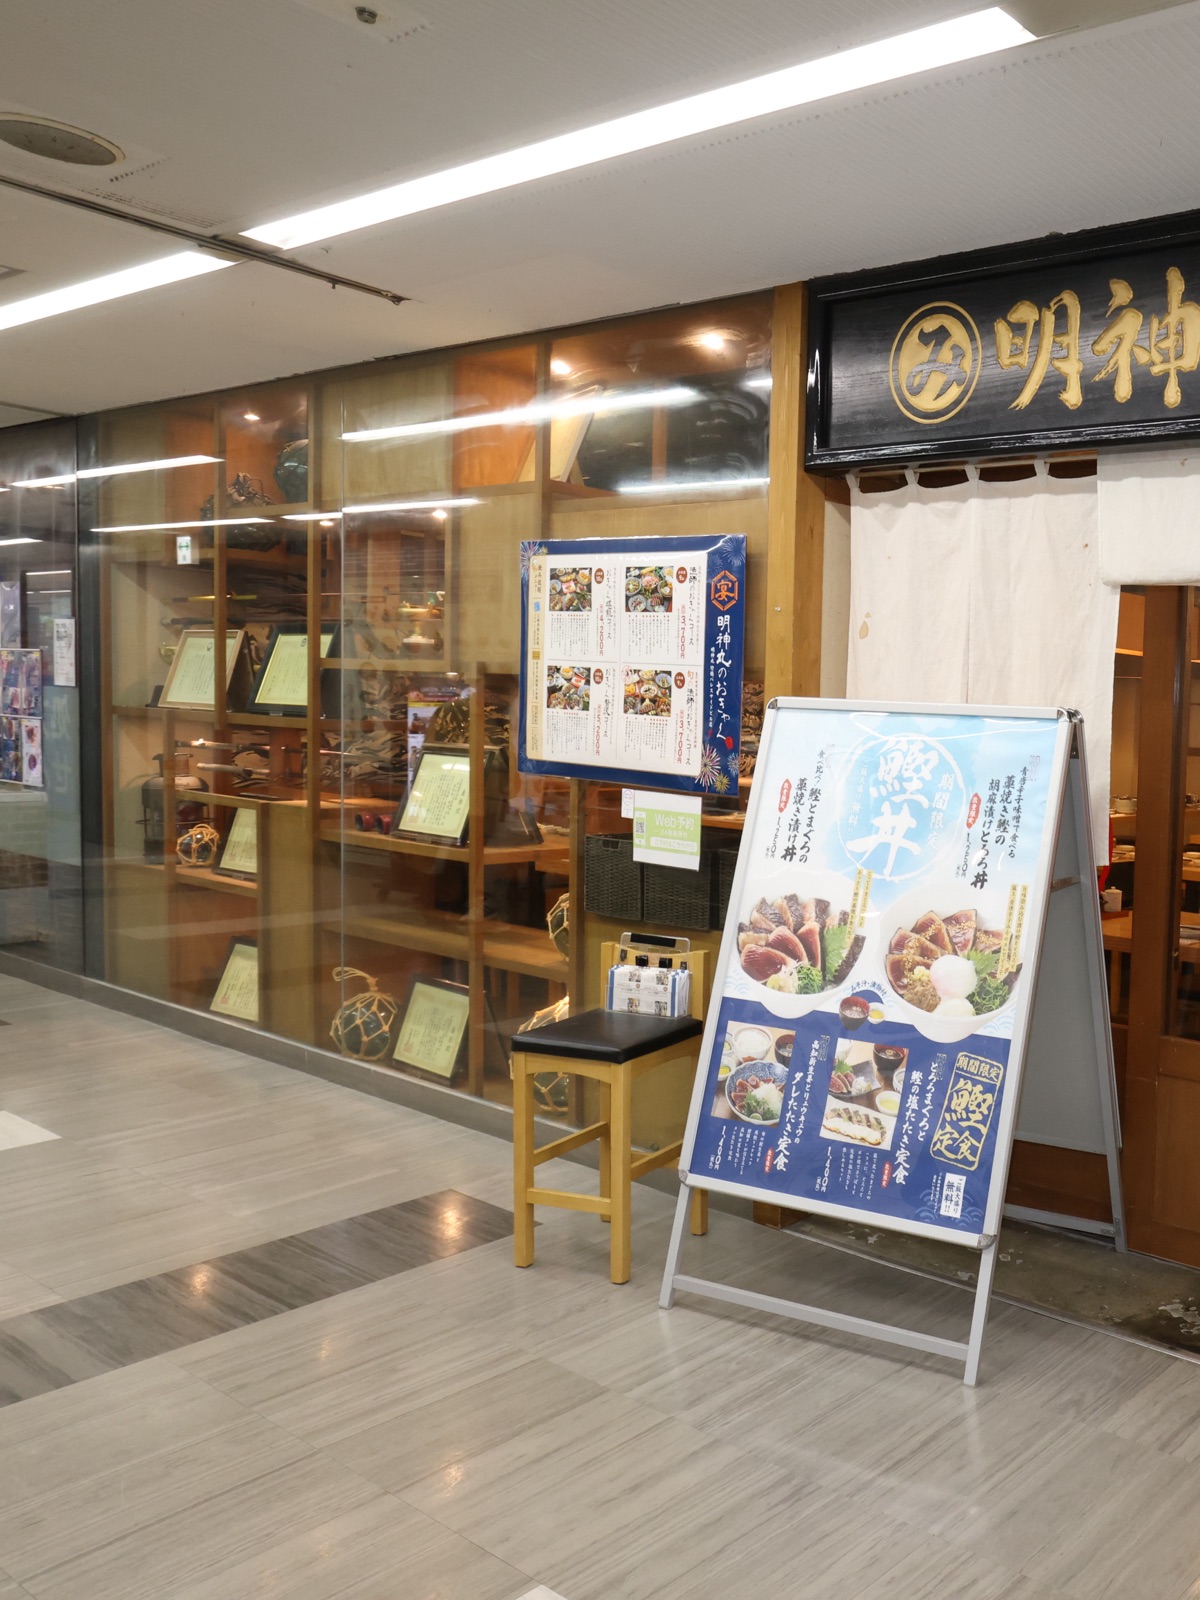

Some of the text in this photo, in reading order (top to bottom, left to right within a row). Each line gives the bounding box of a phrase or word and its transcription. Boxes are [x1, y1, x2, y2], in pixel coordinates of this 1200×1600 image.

[715, 579, 735, 602] 宴
[798, 787, 822, 864] 鰹とまぐろの
[927, 772, 955, 850] 期間限定
[970, 778, 1001, 890] 胡麻漬けとろろ丼
[917, 1061, 939, 1141] とろろまぐろと
[944, 1079, 994, 1135] 鰹
[957, 1055, 1001, 1082] 期間限定
[773, 1071, 804, 1172] タレたたき定食
[892, 1070, 924, 1185] 鰹の塩たたき定食
[953, 1177, 963, 1214] ご飯大盛り
